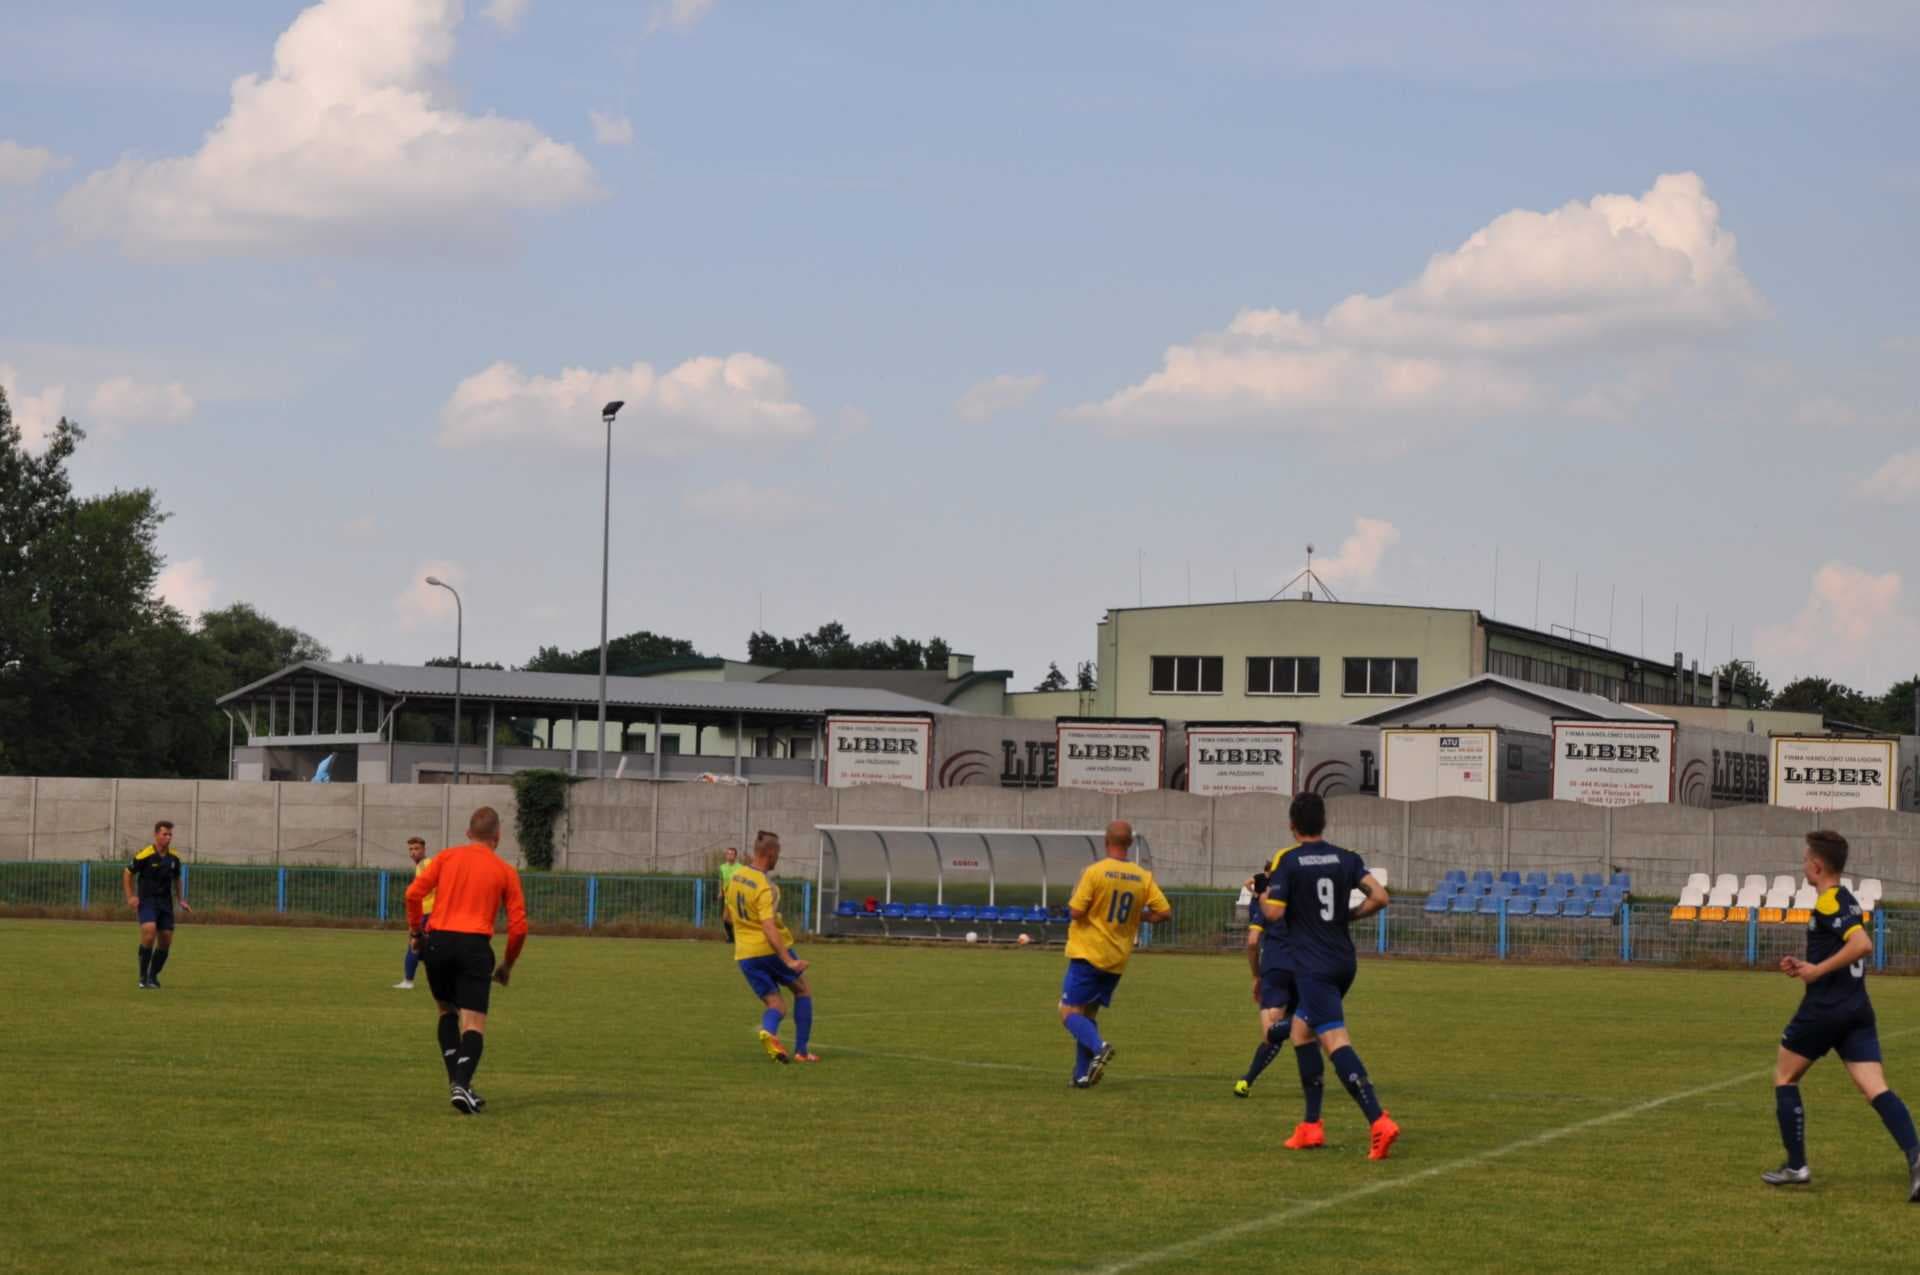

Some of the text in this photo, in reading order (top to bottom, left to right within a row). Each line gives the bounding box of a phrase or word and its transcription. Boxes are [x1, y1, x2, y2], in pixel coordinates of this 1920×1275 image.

[837, 736, 919, 755] LIBER
[1068, 743, 1151, 762] LIBER
[1565, 742, 1660, 763] LIBER
[1198, 748, 1284, 766] LIBER
[1711, 748, 1770, 803] LIBER
[1783, 766, 1882, 787] LIBER
[1107, 889, 1134, 925] 18
[1316, 877, 1335, 922] 9
